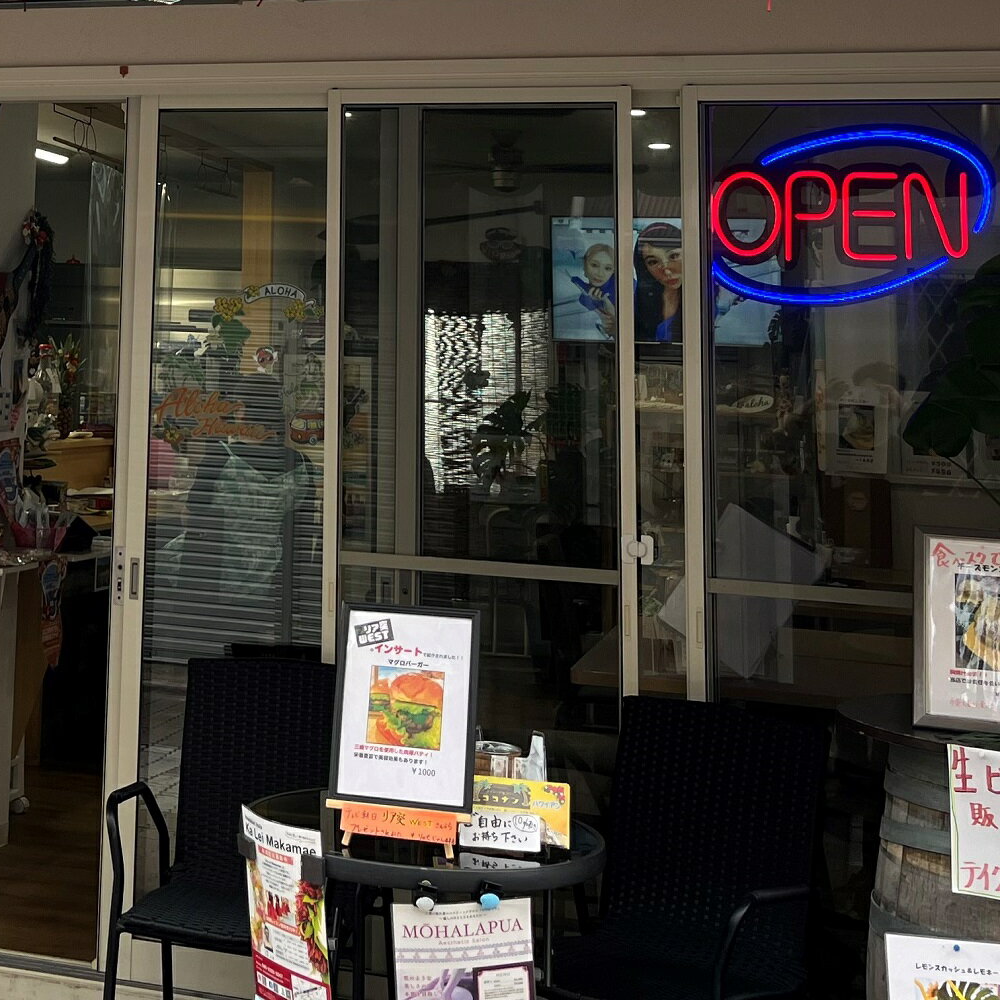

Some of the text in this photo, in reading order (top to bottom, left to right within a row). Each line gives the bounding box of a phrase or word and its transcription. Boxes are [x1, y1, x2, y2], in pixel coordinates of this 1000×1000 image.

[711, 170, 970, 262] OPEN
[264, 286, 298, 298] ALOHA
[358, 630, 390, 645] WEST
[245, 822, 253, 836] Ka
[254, 828, 264, 843] Lei
[266, 835, 317, 856] Makamae
